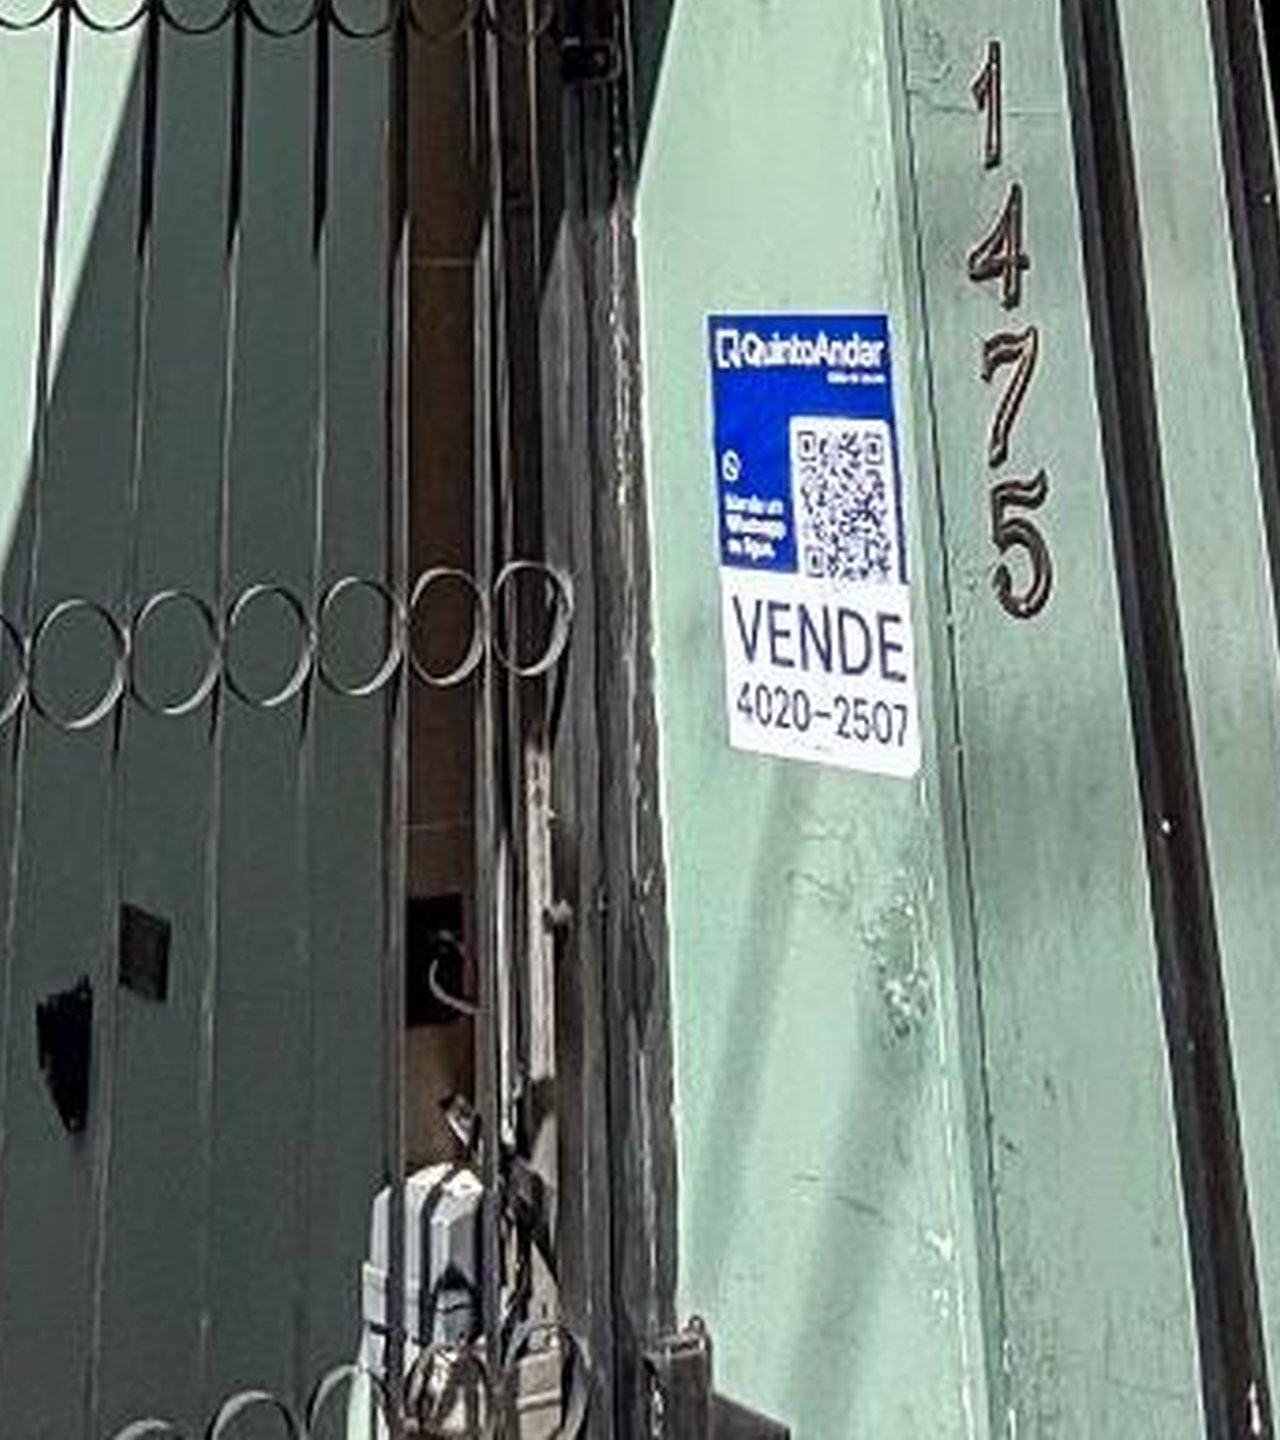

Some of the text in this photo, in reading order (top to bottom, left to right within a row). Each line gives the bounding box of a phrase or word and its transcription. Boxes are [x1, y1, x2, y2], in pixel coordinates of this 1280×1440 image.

[741, 331, 884, 368] QuintoAndar
[968, 40, 1053, 619] 1475
[732, 594, 908, 681] VENDE
[736, 681, 907, 747] 4020-2507
